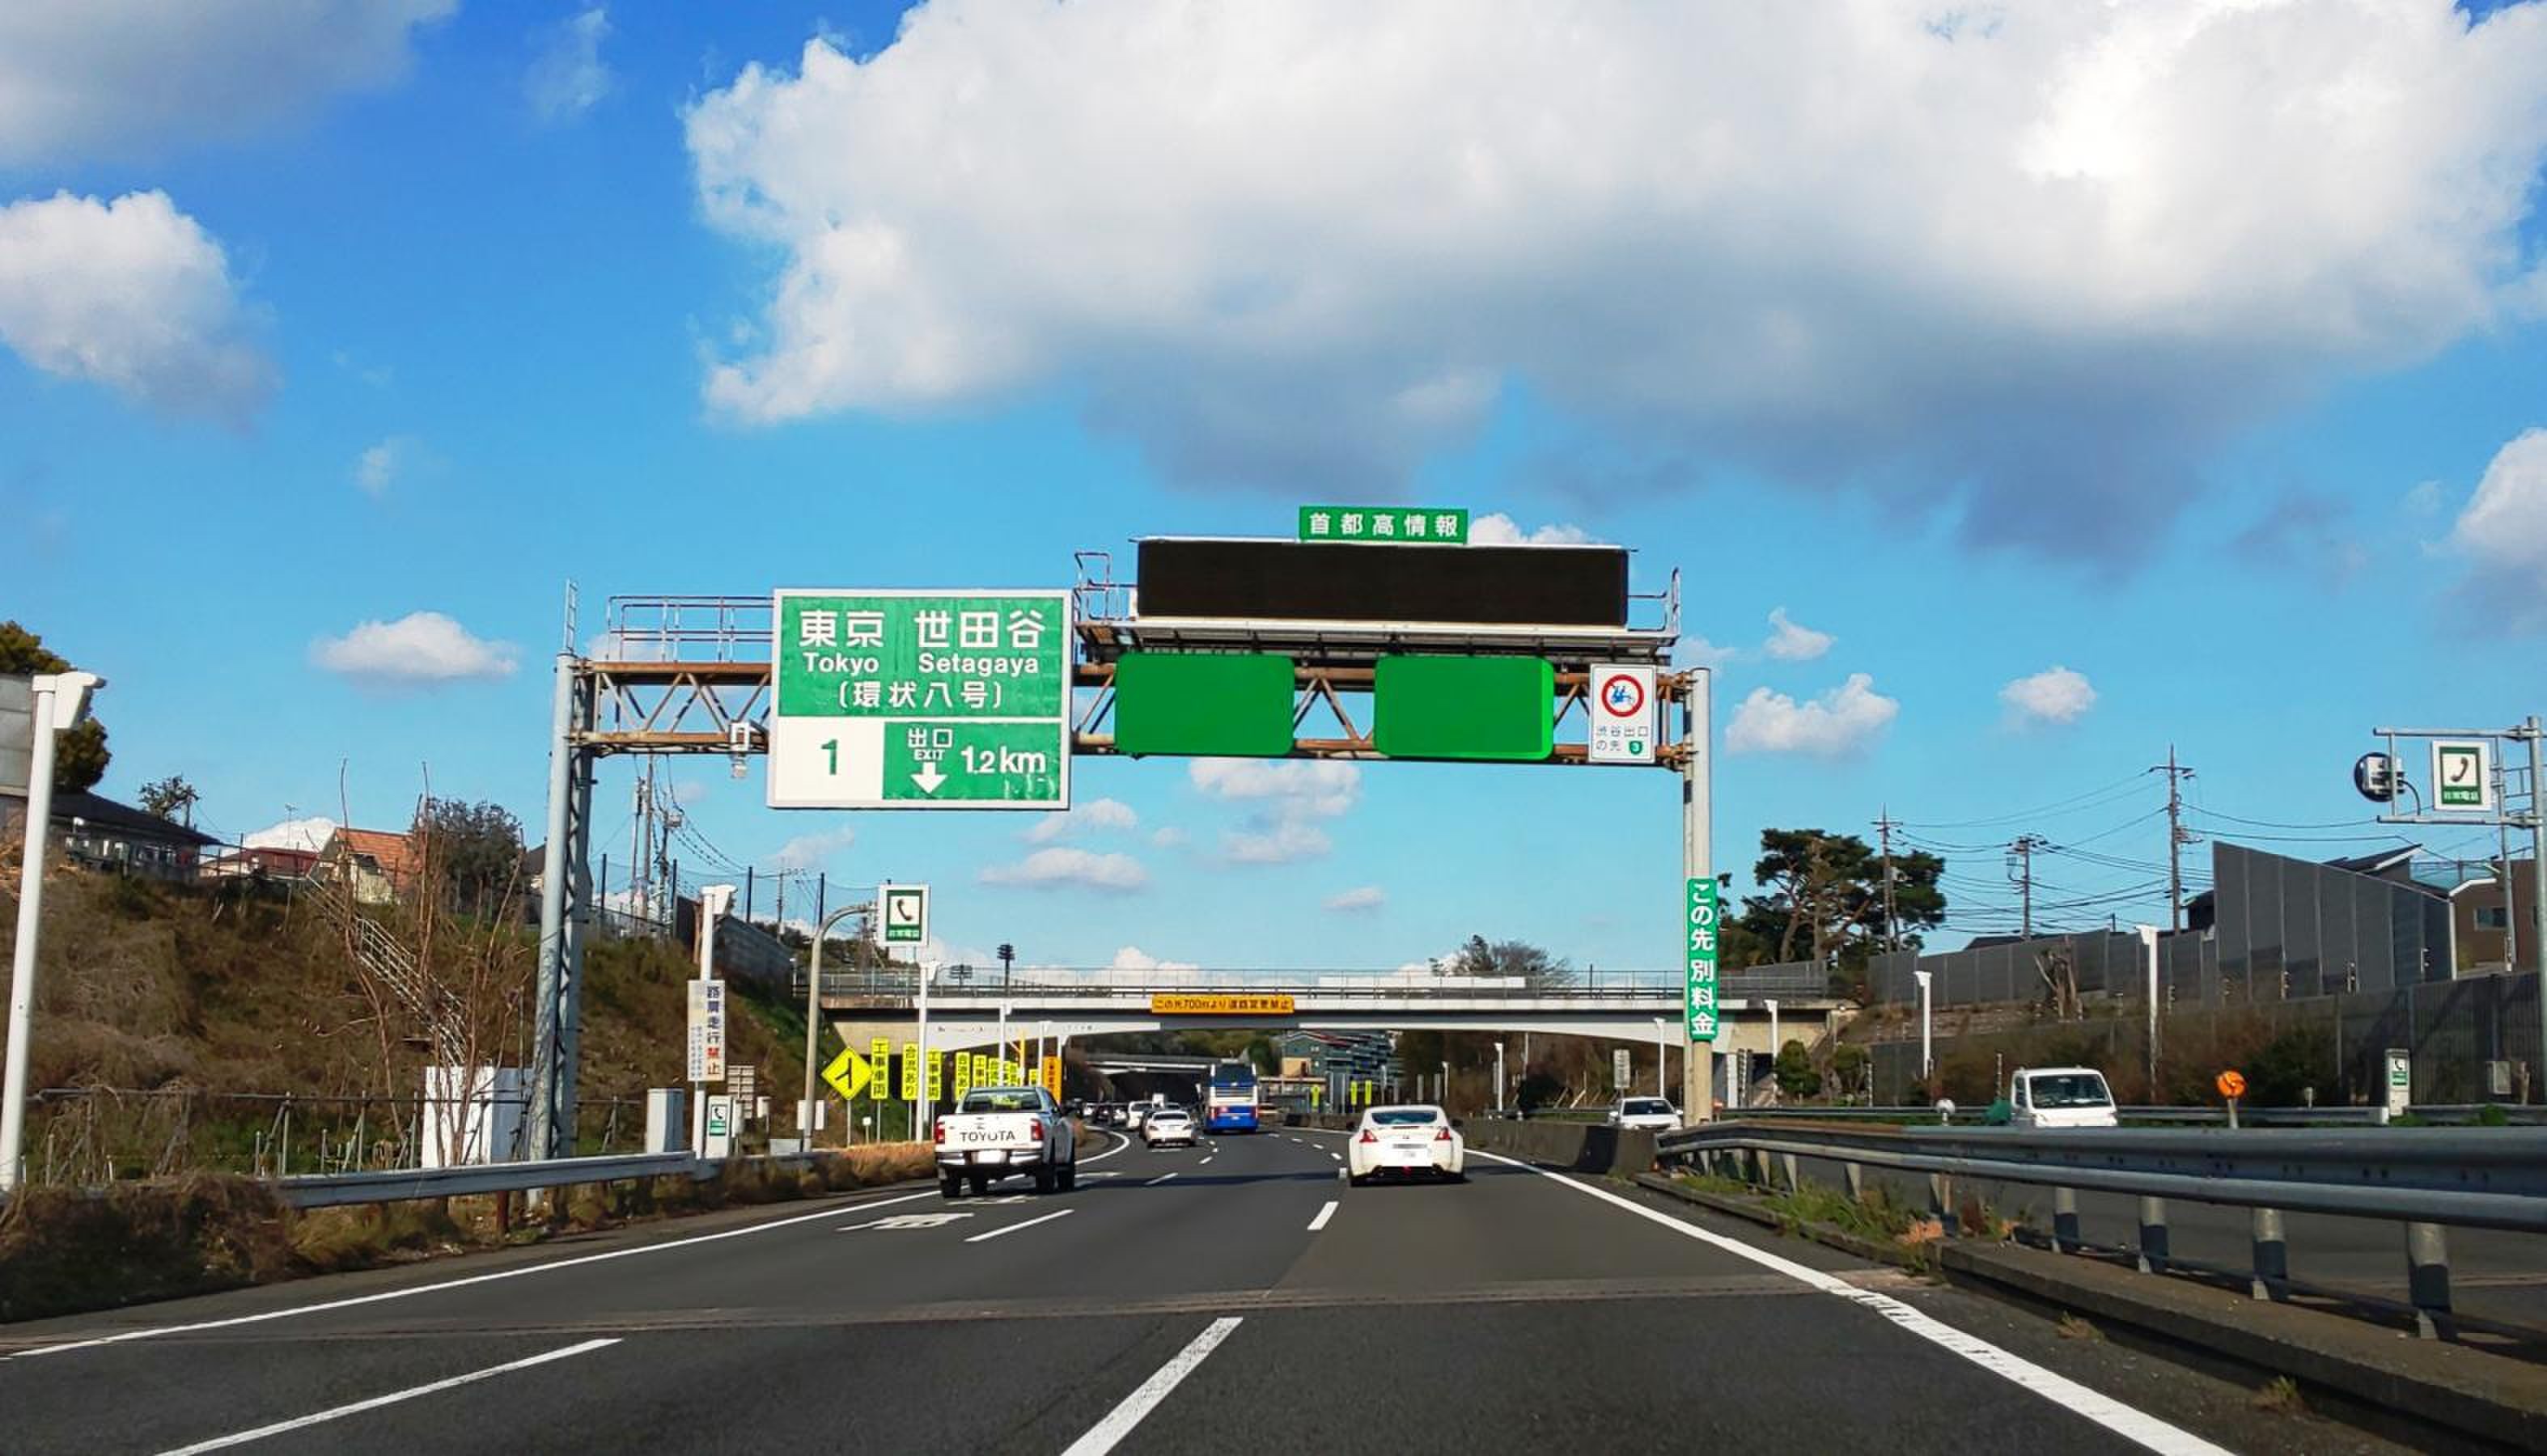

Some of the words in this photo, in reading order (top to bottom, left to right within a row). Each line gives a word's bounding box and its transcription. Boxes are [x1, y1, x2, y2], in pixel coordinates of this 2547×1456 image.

[1308, 513, 1458, 537] 首都高情報
[799, 610, 885, 648] 東京
[914, 609, 1046, 649] 世田谷
[803, 652, 879, 677] Tokyo
[918, 653, 1039, 678] Setagaya
[908, 728, 953, 749] 出口
[820, 739, 839, 776] 1
[913, 749, 946, 761] EXIT
[960, 1130, 1016, 1143] TOYOTA
